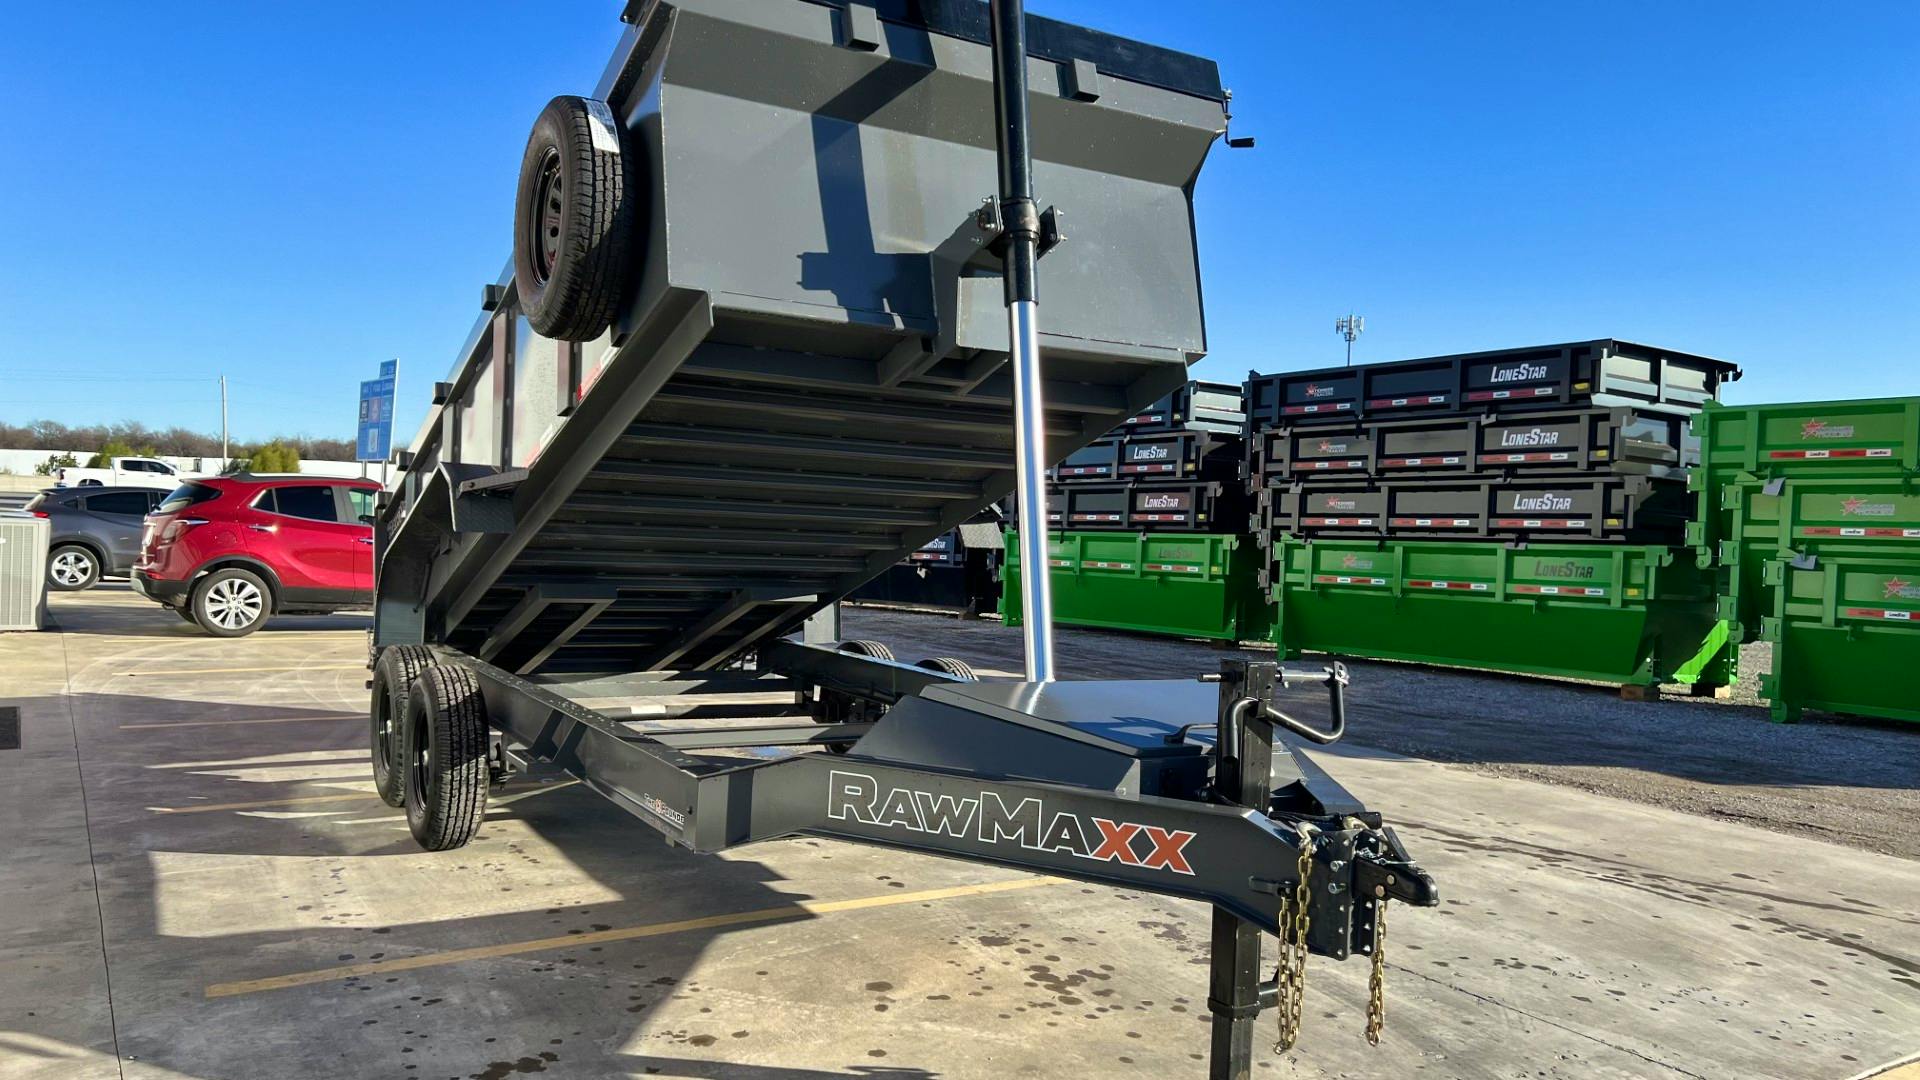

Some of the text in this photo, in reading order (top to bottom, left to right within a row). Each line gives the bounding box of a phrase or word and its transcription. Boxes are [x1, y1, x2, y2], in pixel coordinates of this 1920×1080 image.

[1490, 363, 1547, 383] LONESTAR
[1501, 428, 1559, 447] LONESTAR
[1513, 493, 1572, 511] LONESTAR
[827, 769, 1197, 877] RAWMAXX
